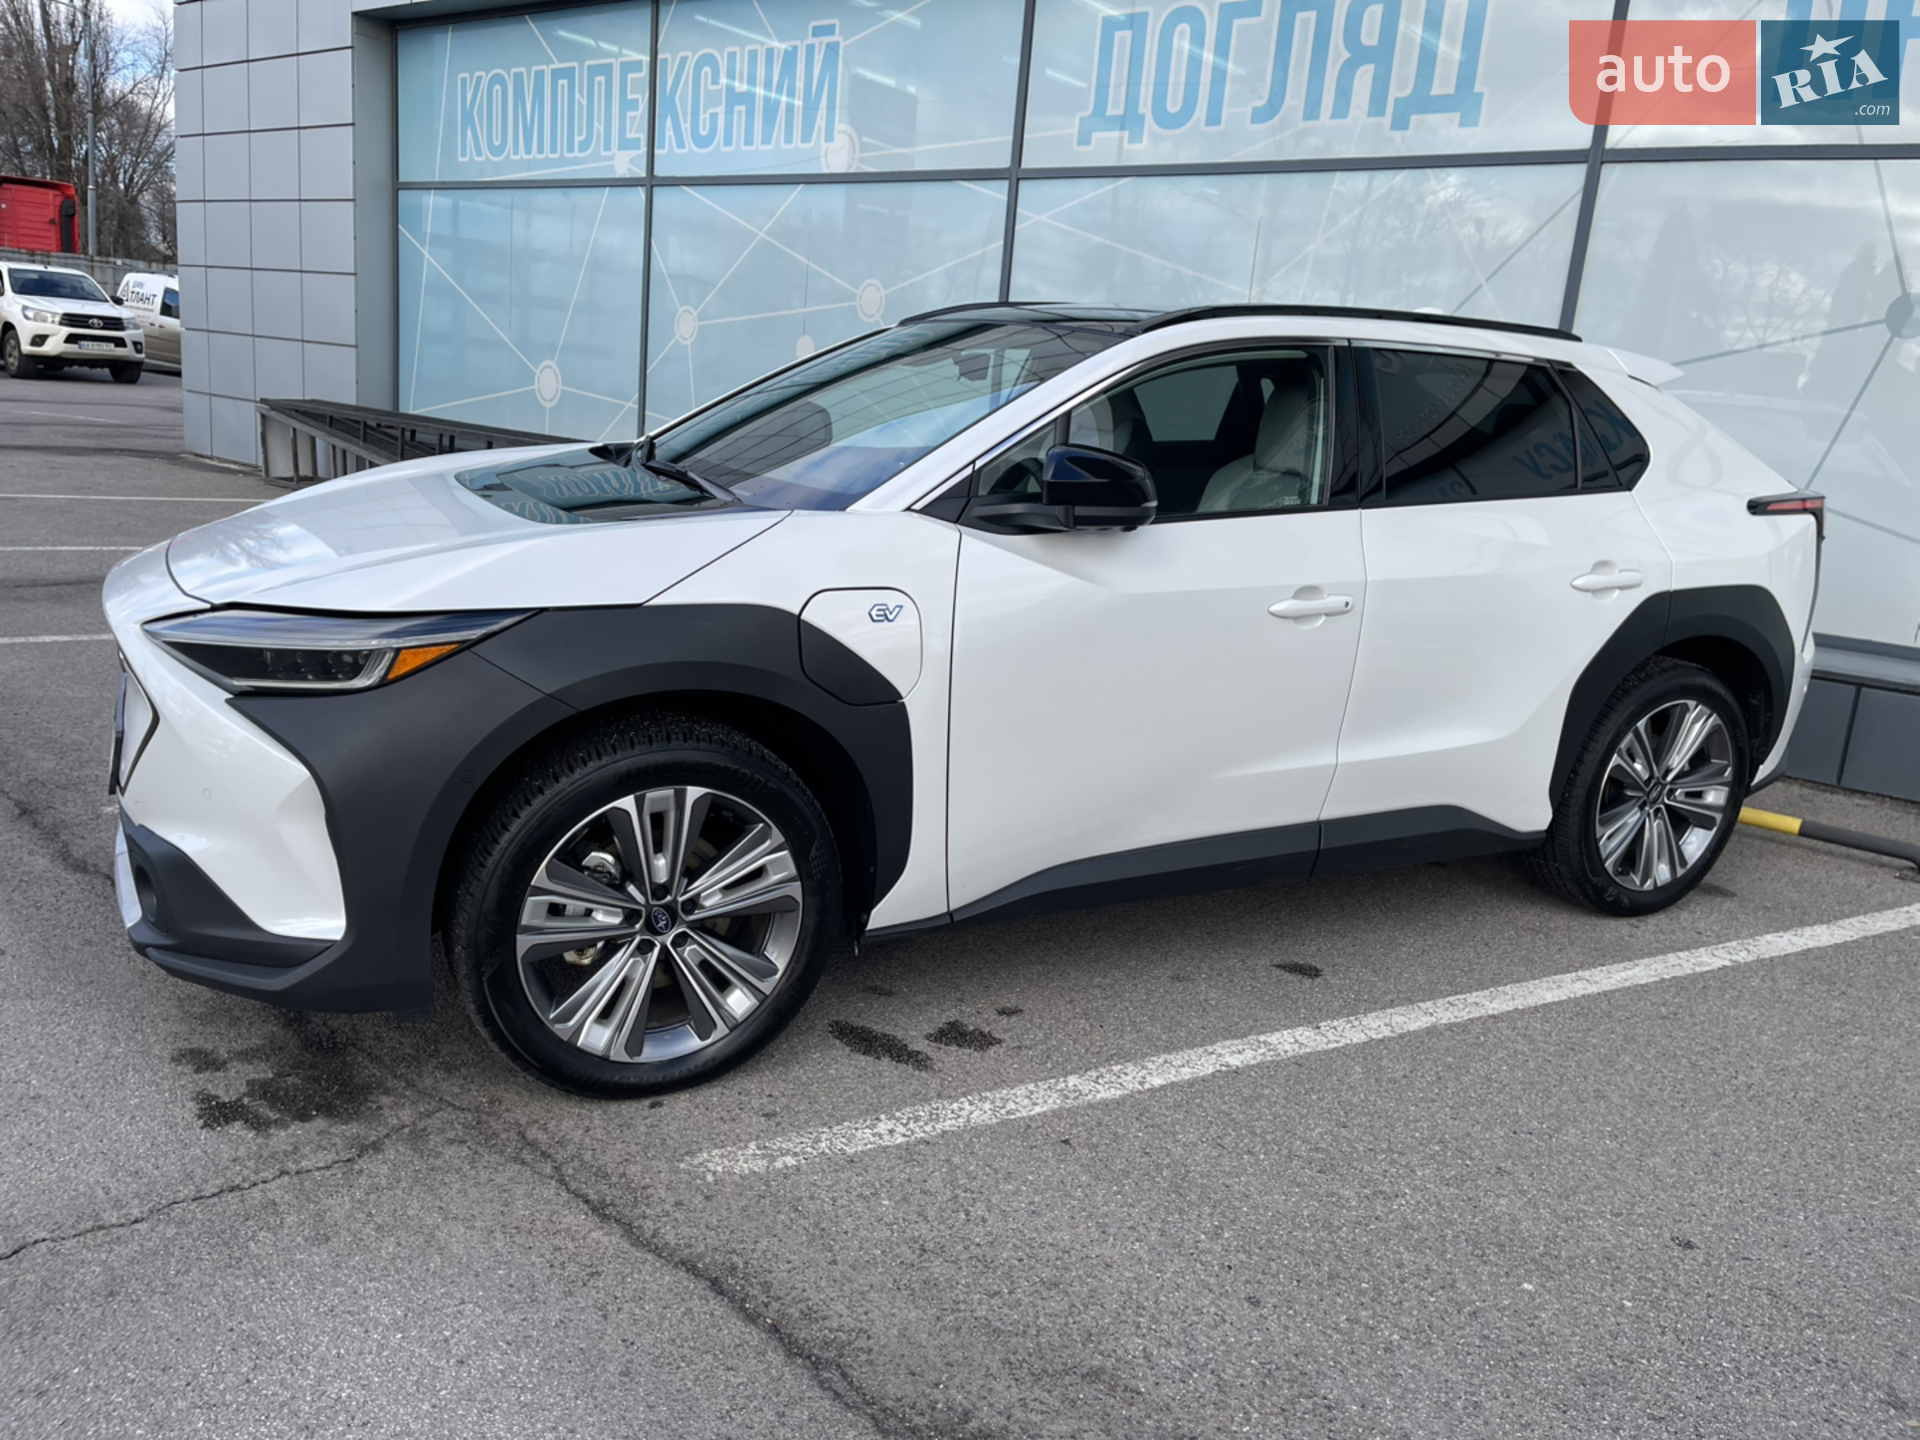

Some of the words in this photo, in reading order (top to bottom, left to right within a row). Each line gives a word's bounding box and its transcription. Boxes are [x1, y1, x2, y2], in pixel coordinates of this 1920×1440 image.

[458, 19, 843, 162] КОМПЛЕКСНИЙ
[1073, 0, 1489, 151] ДОГЛЯД
[867, 603, 904, 623] EV
